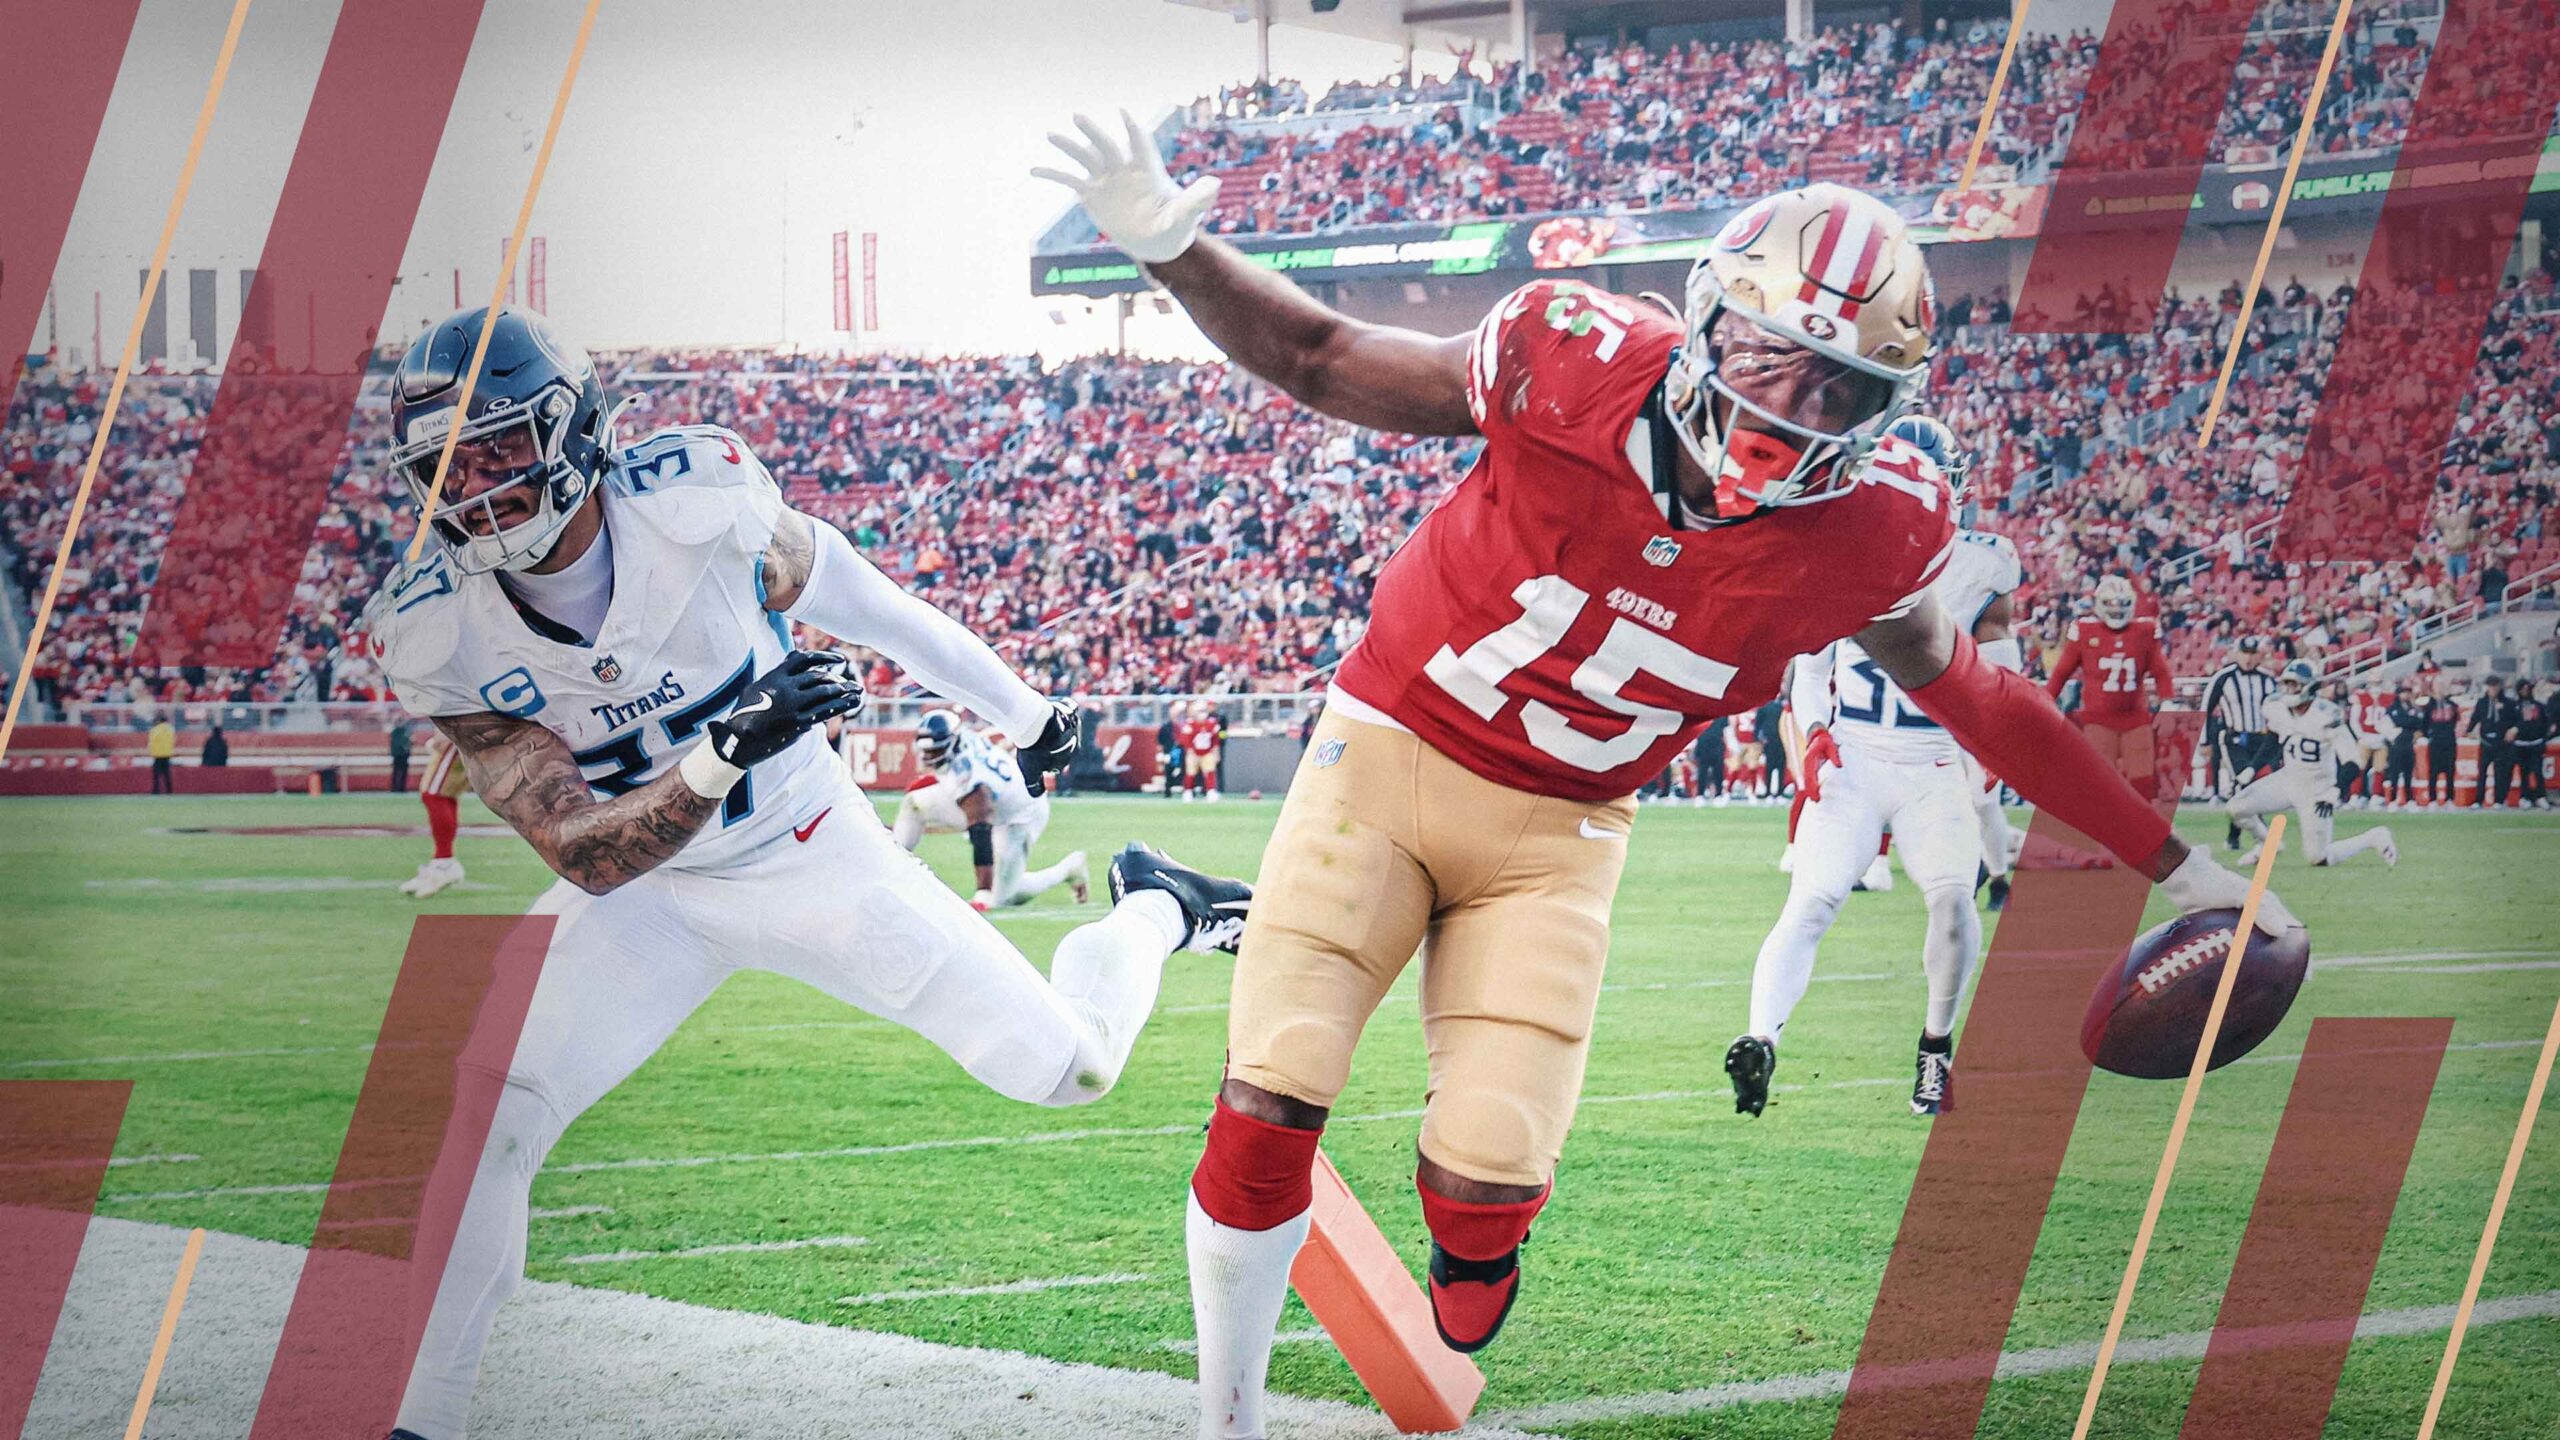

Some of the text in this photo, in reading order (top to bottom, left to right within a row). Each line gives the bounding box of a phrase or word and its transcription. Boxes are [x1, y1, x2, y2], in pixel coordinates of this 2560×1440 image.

[1605, 586, 1678, 631] 49ERS
[599, 665, 620, 681] NFL
[1424, 574, 1739, 773] 15
[2098, 656, 2137, 692] 71
[590, 671, 685, 733] TITANS
